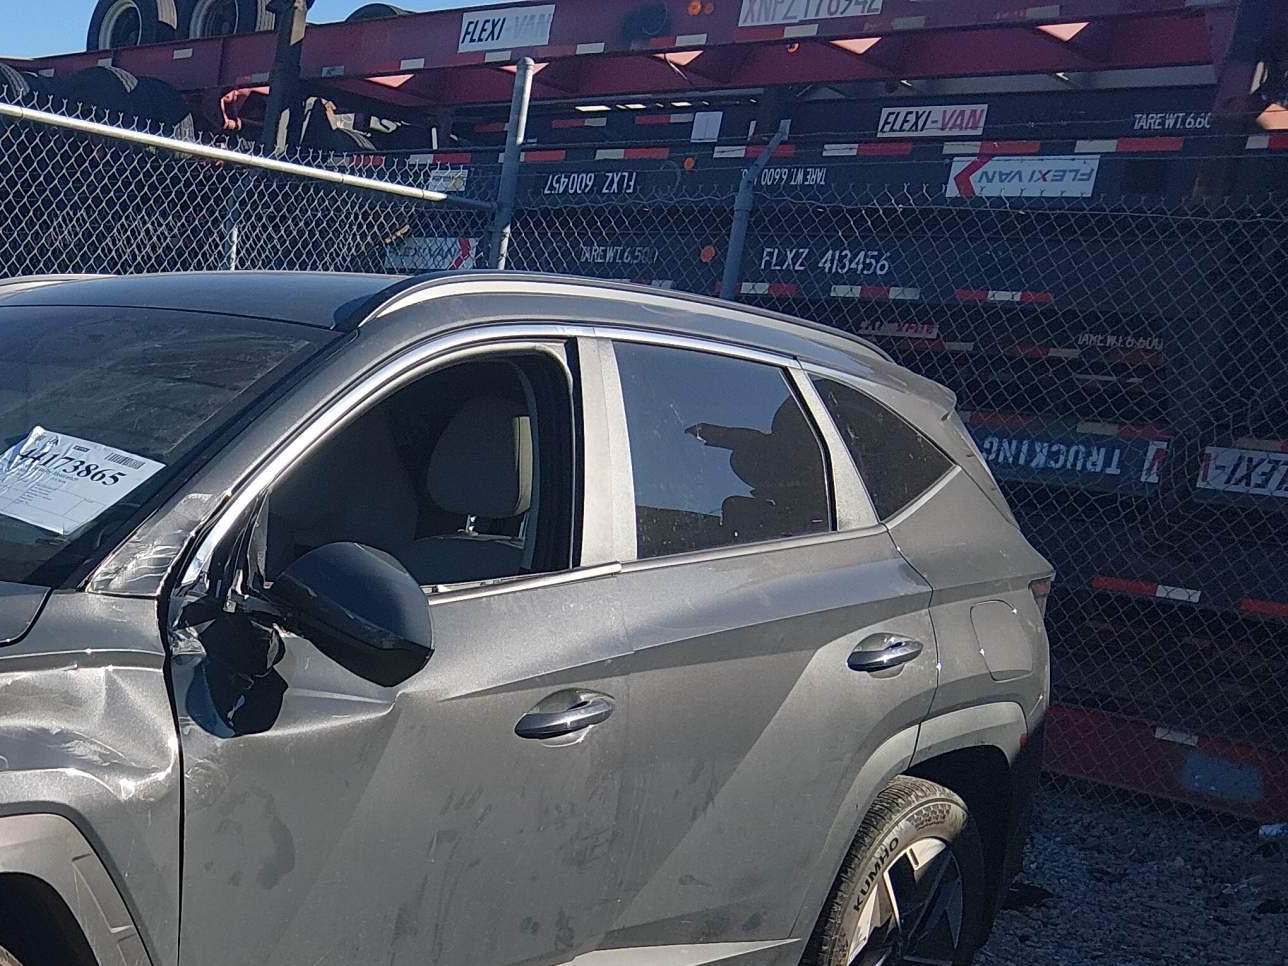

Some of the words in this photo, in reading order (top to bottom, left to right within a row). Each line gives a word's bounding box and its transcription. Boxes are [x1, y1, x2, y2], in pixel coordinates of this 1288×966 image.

[880, 109, 984, 133] FLEXI-VAN
[544, 173, 594, 194] 600457
[603, 172, 636, 193] FLXZ
[804, 168, 827, 184] TARE
[762, 248, 809, 270] FLXZ
[818, 250, 890, 274] 413456
[19, 449, 128, 487] 44173865
[983, 437, 1121, 474] TRUCKING
[853, 836, 900, 913] KUMHO
